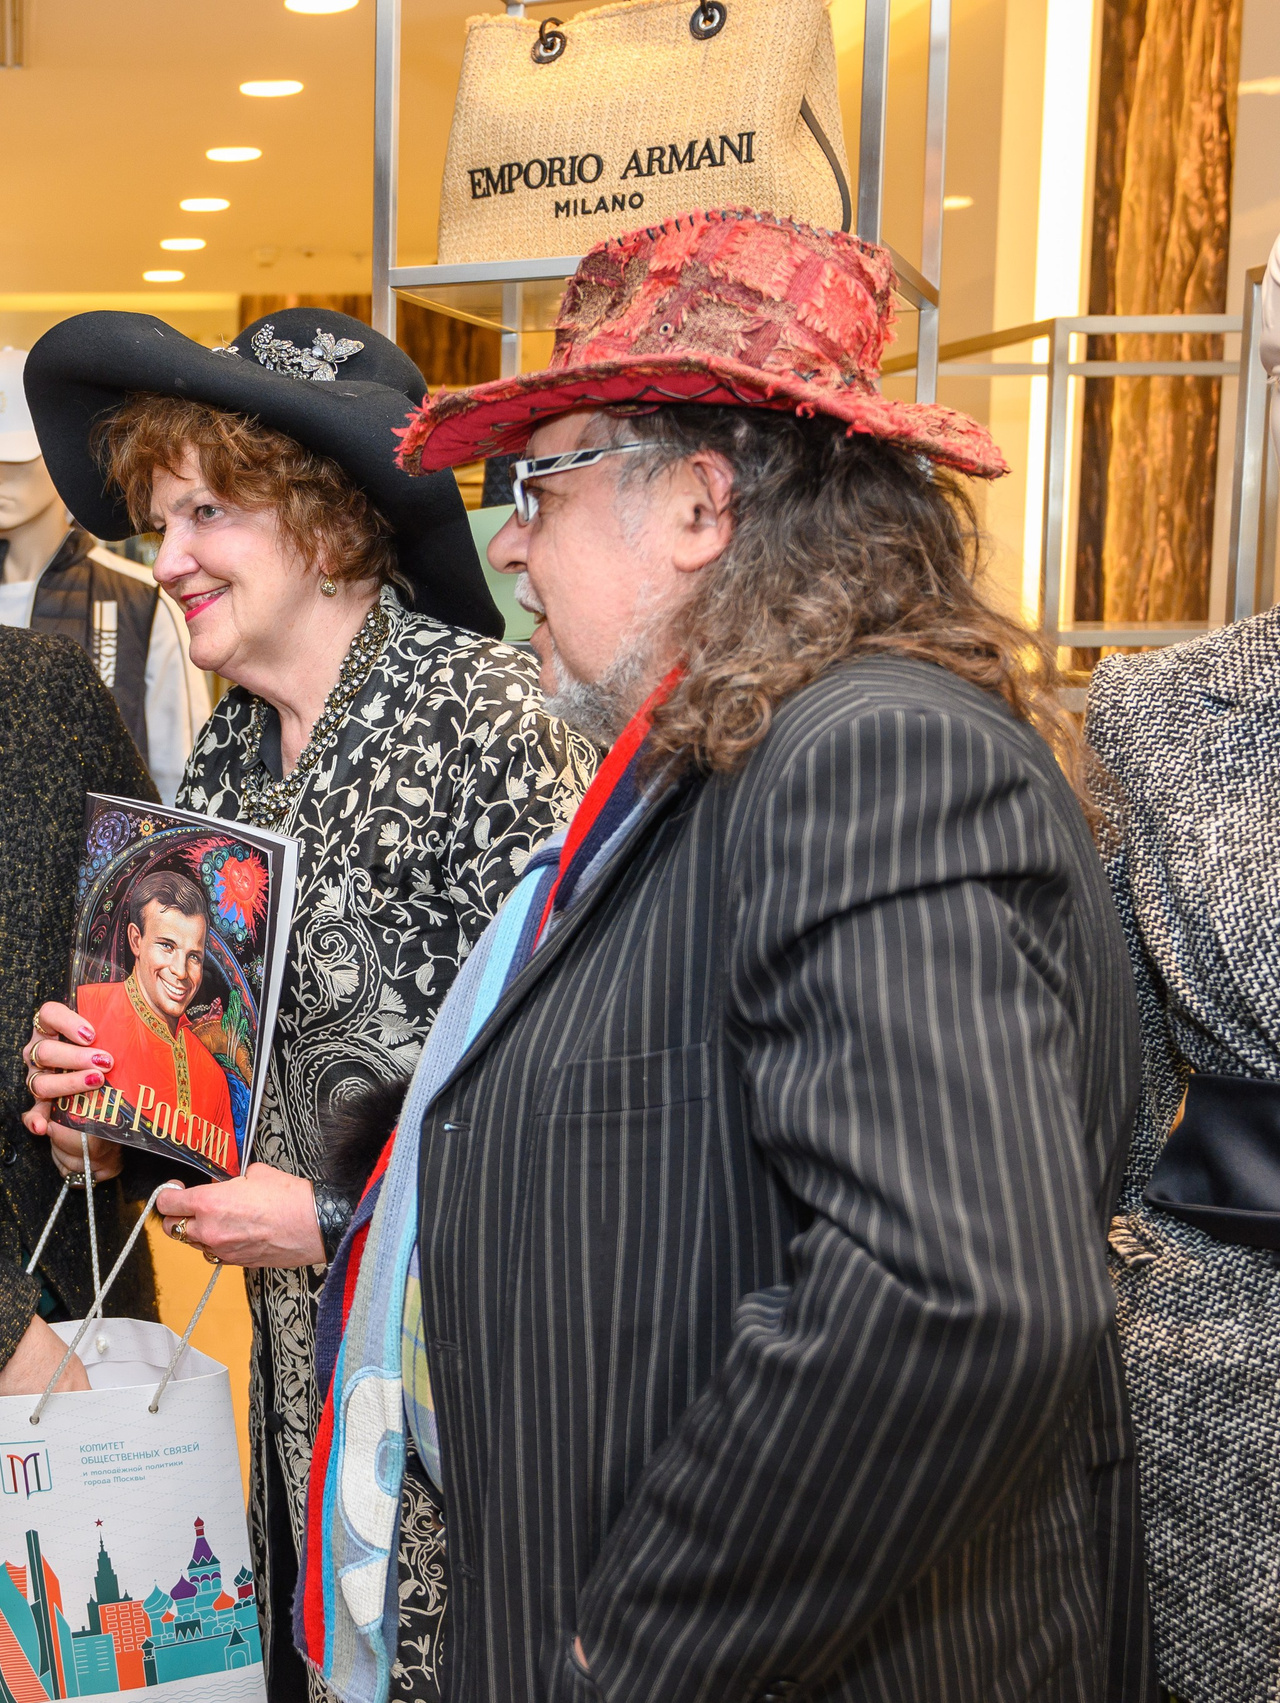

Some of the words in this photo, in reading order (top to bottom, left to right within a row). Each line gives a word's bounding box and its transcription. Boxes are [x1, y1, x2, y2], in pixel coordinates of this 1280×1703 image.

[467, 153, 604, 200] EMPORIO
[620, 131, 756, 180] ARMANI
[554, 192, 644, 218] MILANO
[100, 631, 117, 688] BOSS
[79, 1440, 125, 1453] КОМИТЕТ
[80, 1449, 160, 1465] ОБЩЕСТВЕННЫХ
[163, 1442, 200, 1456] СВЯЗЕЙ
[90, 1465, 143, 1476] молодёжной
[145, 1460, 184, 1470] политики
[83, 1477, 111, 1486] города
[113, 1475, 146, 1483] Москвы
